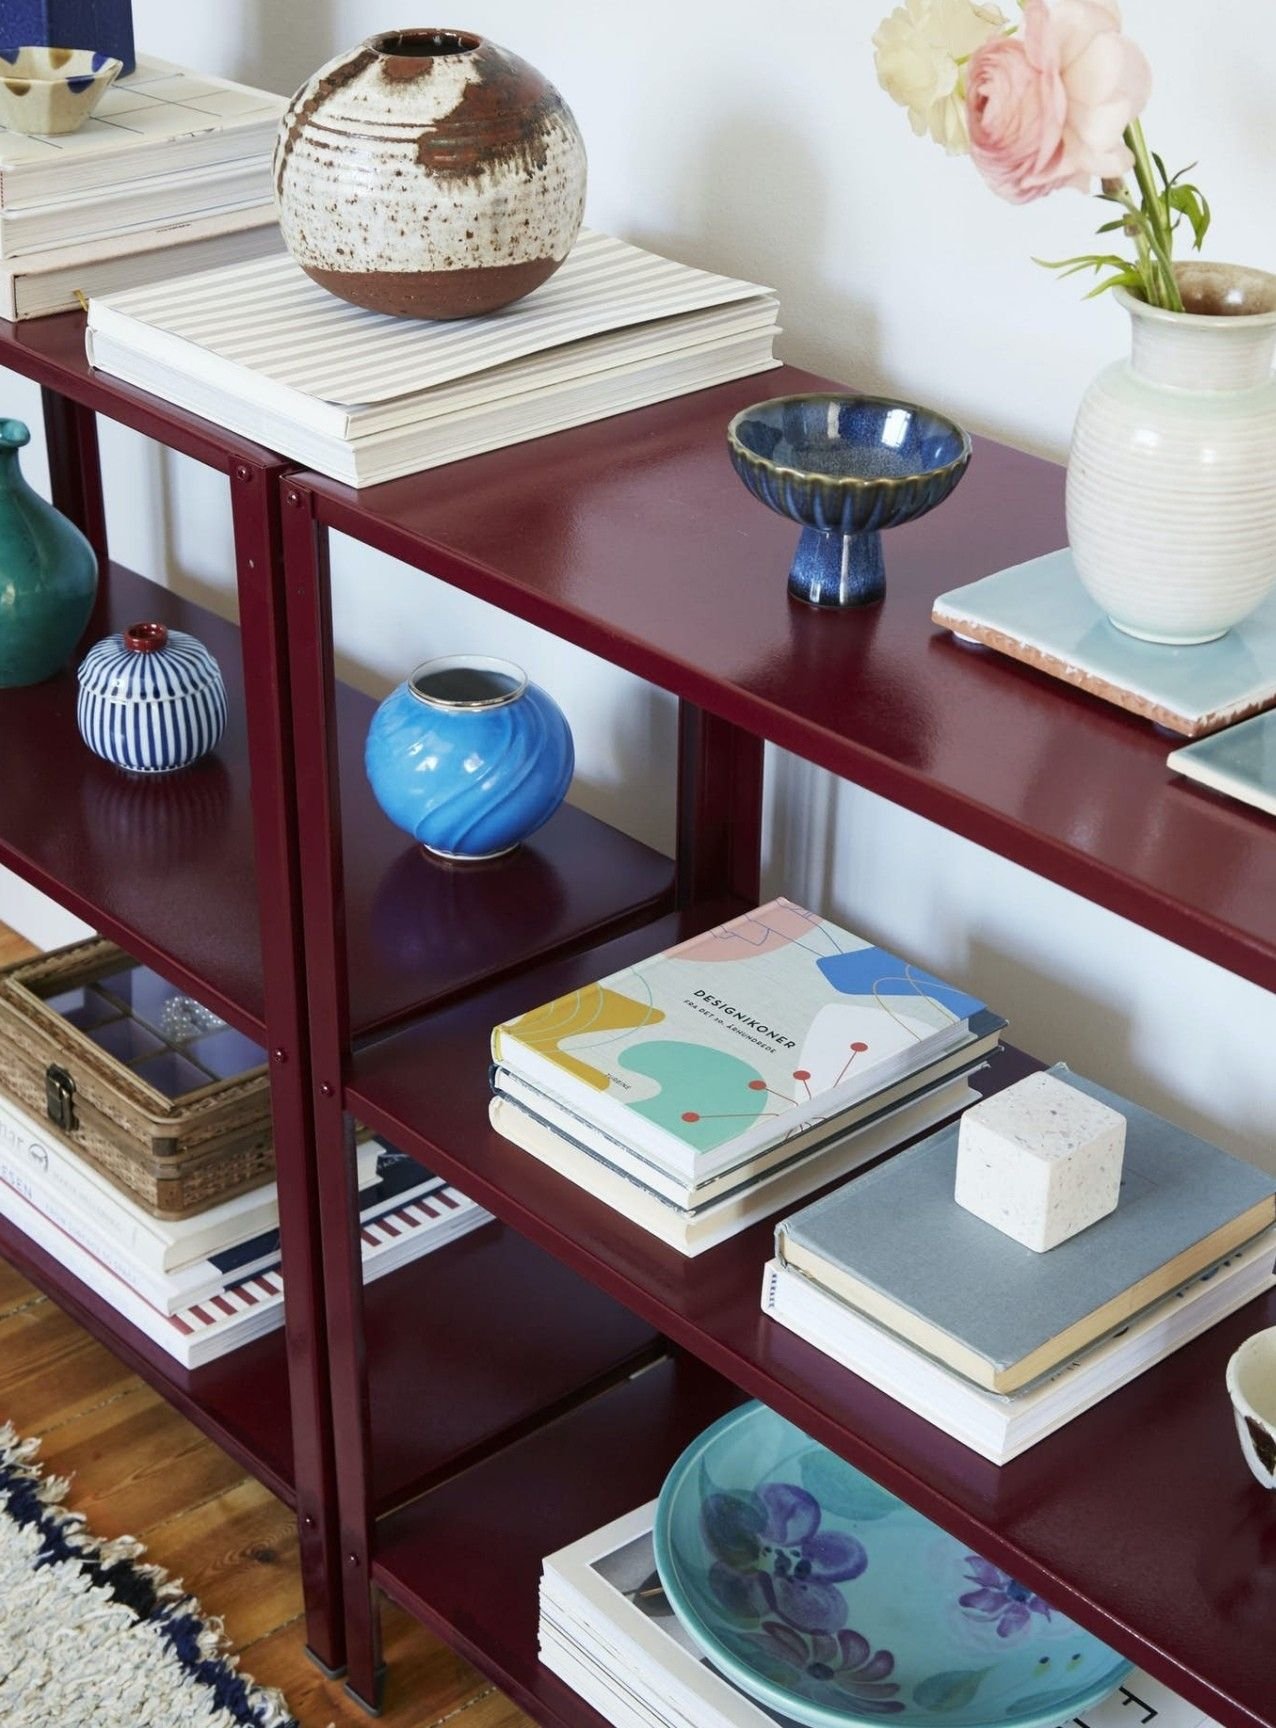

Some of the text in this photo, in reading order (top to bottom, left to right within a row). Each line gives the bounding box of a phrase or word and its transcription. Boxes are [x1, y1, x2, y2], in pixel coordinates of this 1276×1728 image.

[683, 999, 698, 1009] FRA
[698, 1008, 715, 1018] DET
[693, 989, 796, 1049] DESIGNIKONER
